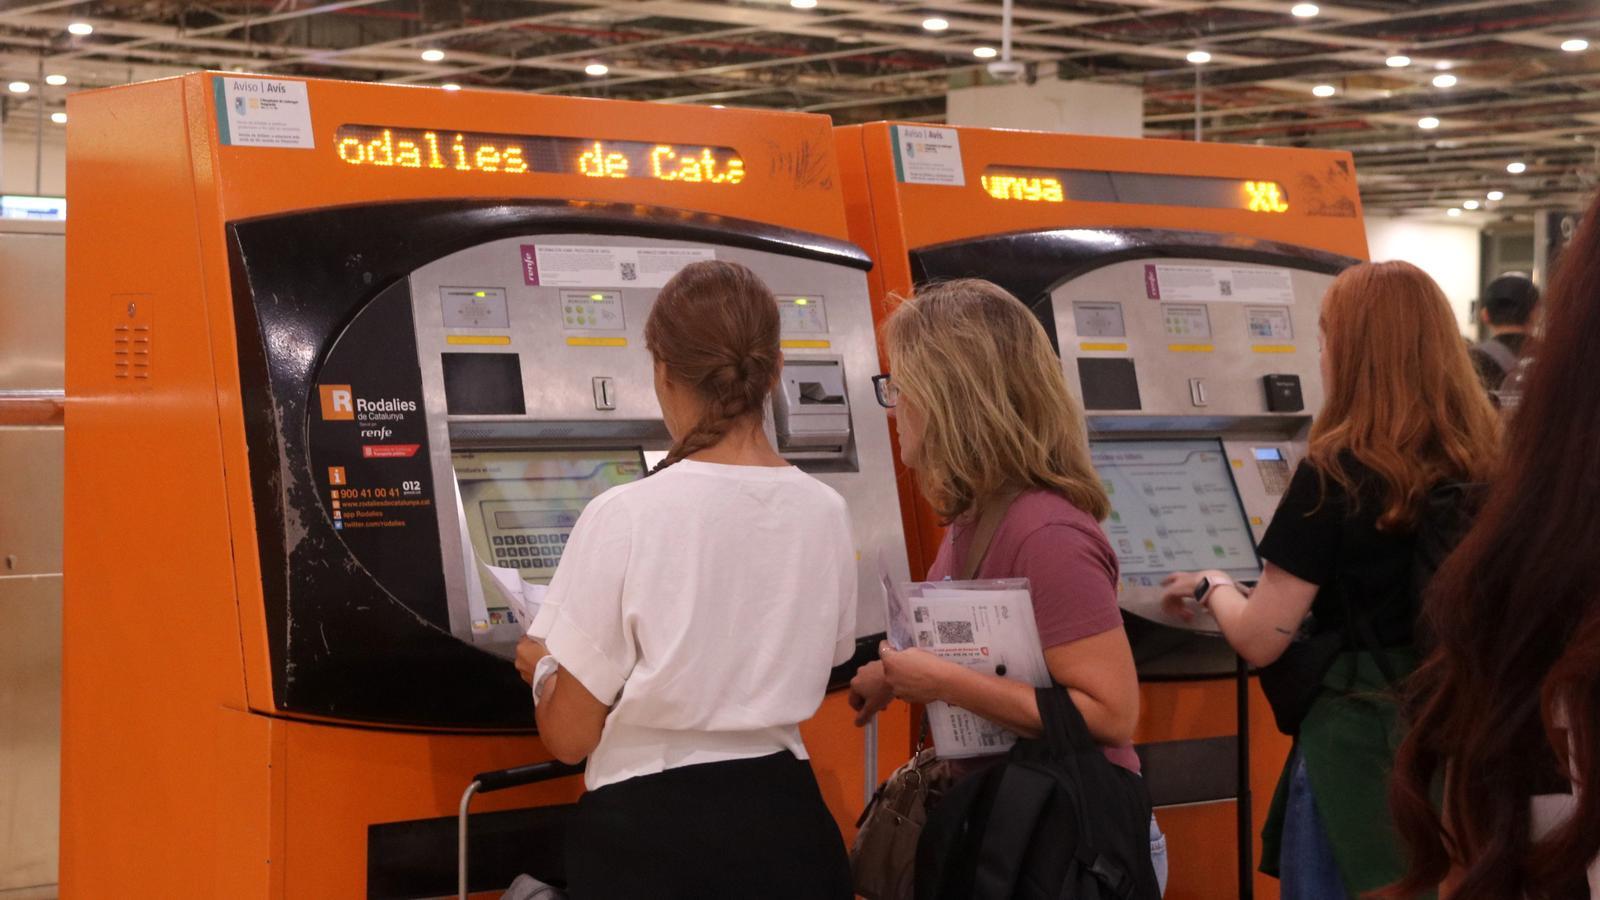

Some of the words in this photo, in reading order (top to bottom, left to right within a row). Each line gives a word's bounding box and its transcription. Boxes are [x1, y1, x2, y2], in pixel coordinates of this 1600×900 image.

[233, 81, 258, 92] Aviso
[338, 128, 528, 173] odalies
[579, 142, 628, 178] de
[652, 145, 745, 184] Cata
[332, 389, 353, 412] R
[356, 398, 417, 412] Rodalies
[358, 412, 367, 420] de
[369, 412, 404, 422] Catalunya
[361, 426, 393, 440] renfe
[402, 481, 421, 491] 012
[340, 489, 358, 499] 900
[360, 489, 372, 498] 41
[374, 488, 387, 498] 00
[388, 488, 400, 497] 41
